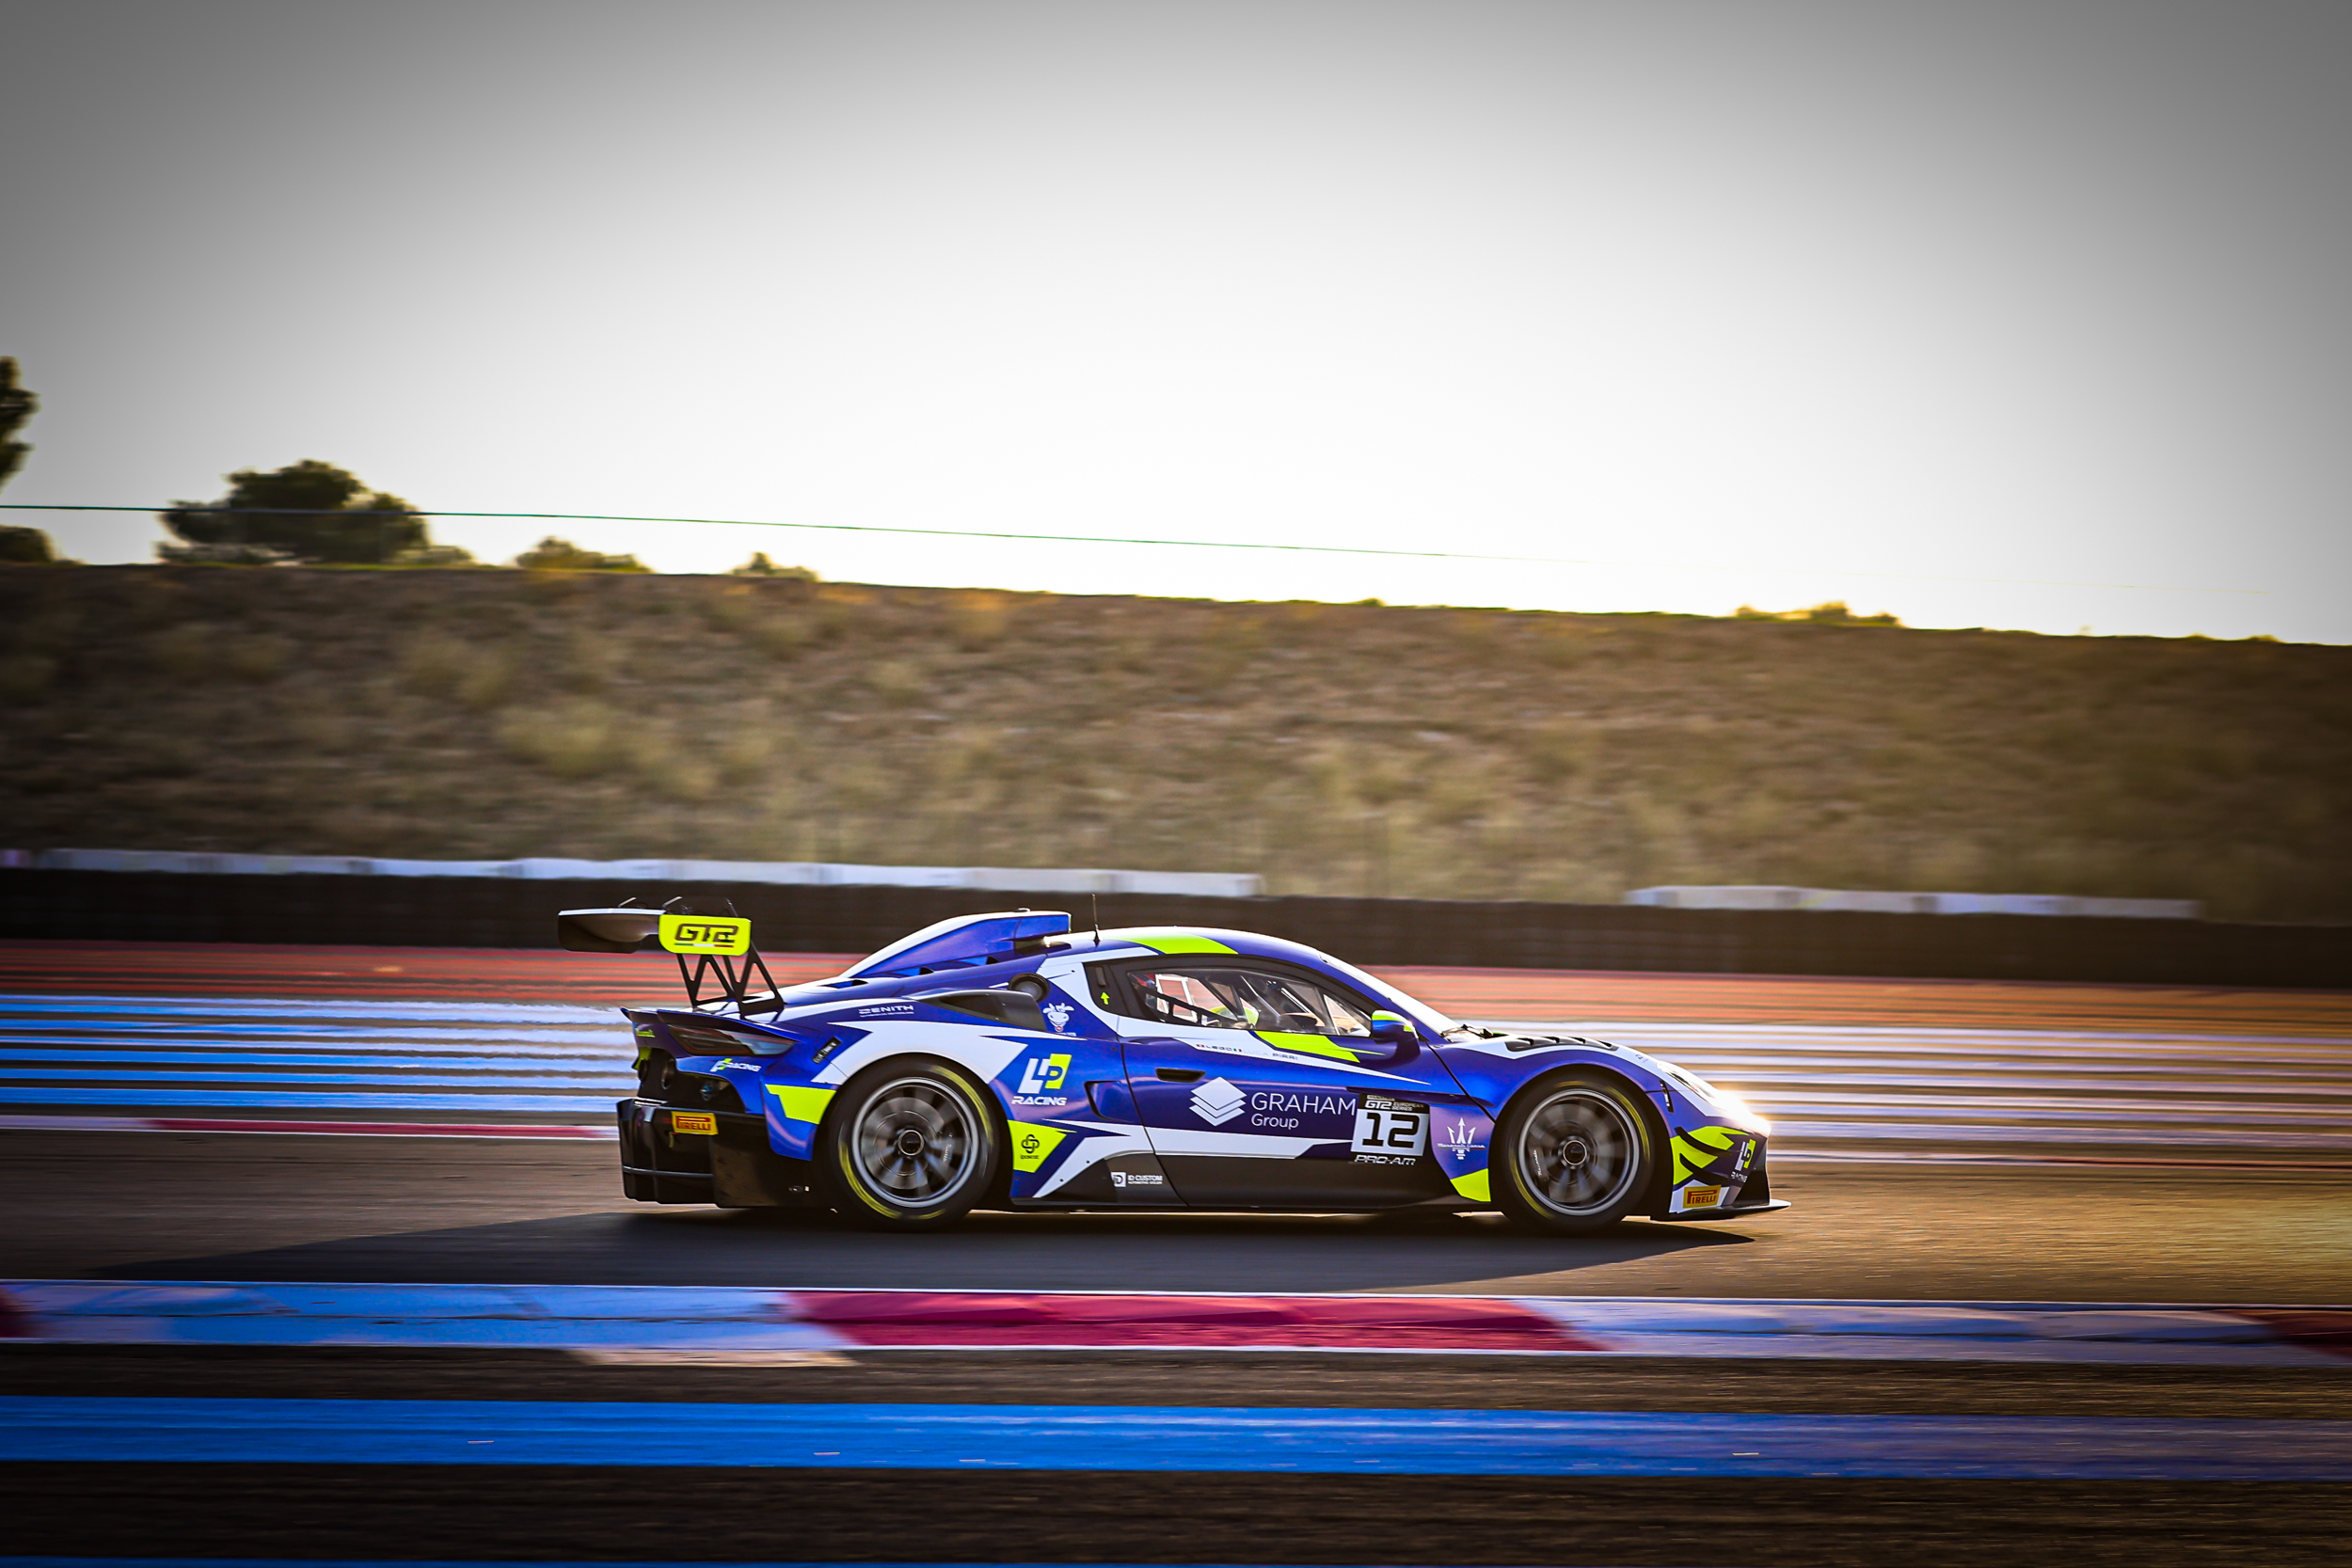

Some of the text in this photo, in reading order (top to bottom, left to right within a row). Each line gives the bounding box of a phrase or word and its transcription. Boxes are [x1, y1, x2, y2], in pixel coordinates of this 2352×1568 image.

[675, 923, 739, 943] GT2
[858, 1005, 914, 1014] ZENITH
[1010, 1096, 1068, 1106] RACING
[1250, 1092, 1357, 1117] GRAHAM
[1364, 1100, 1392, 1110] GT2
[675, 1115, 711, 1132] PIRELLI
[1250, 1113, 1299, 1131] Group
[1361, 1112, 1420, 1149] 12
[1354, 1154, 1417, 1166] PRO-AM
[1687, 1189, 1718, 1205] PIRELLI
